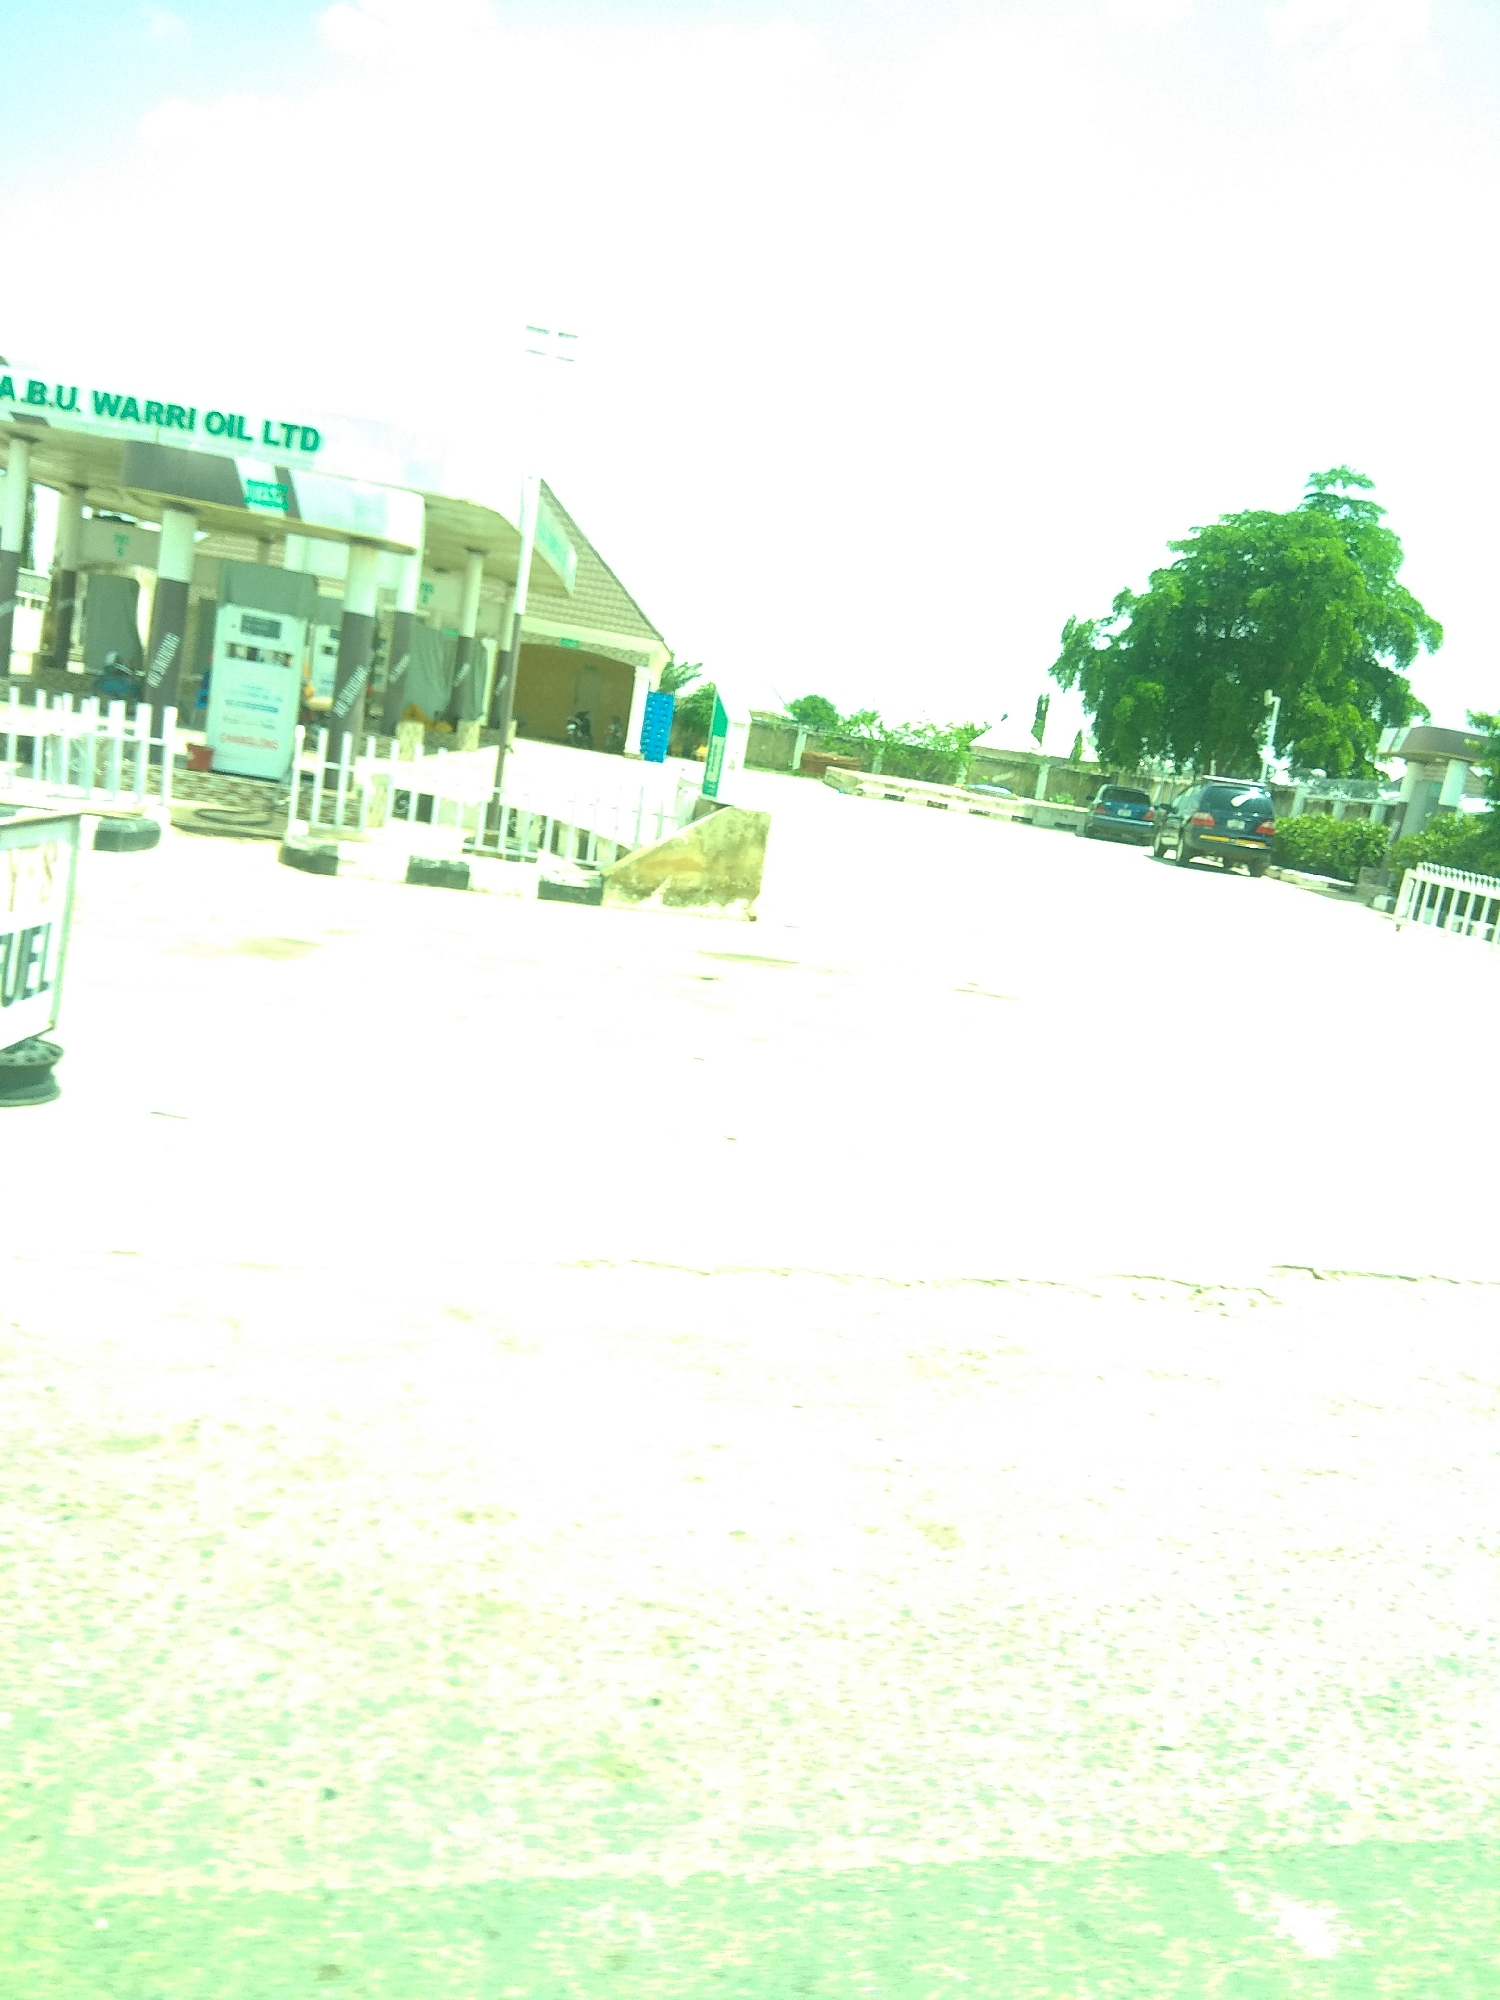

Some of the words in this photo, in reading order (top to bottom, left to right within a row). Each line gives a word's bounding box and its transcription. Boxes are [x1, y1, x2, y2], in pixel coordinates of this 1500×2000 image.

[0, 375, 81, 412] A.B.U.
[92, 390, 198, 432] WARRI
[203, 410, 254, 442] OIL
[262, 420, 322, 453] LTD
